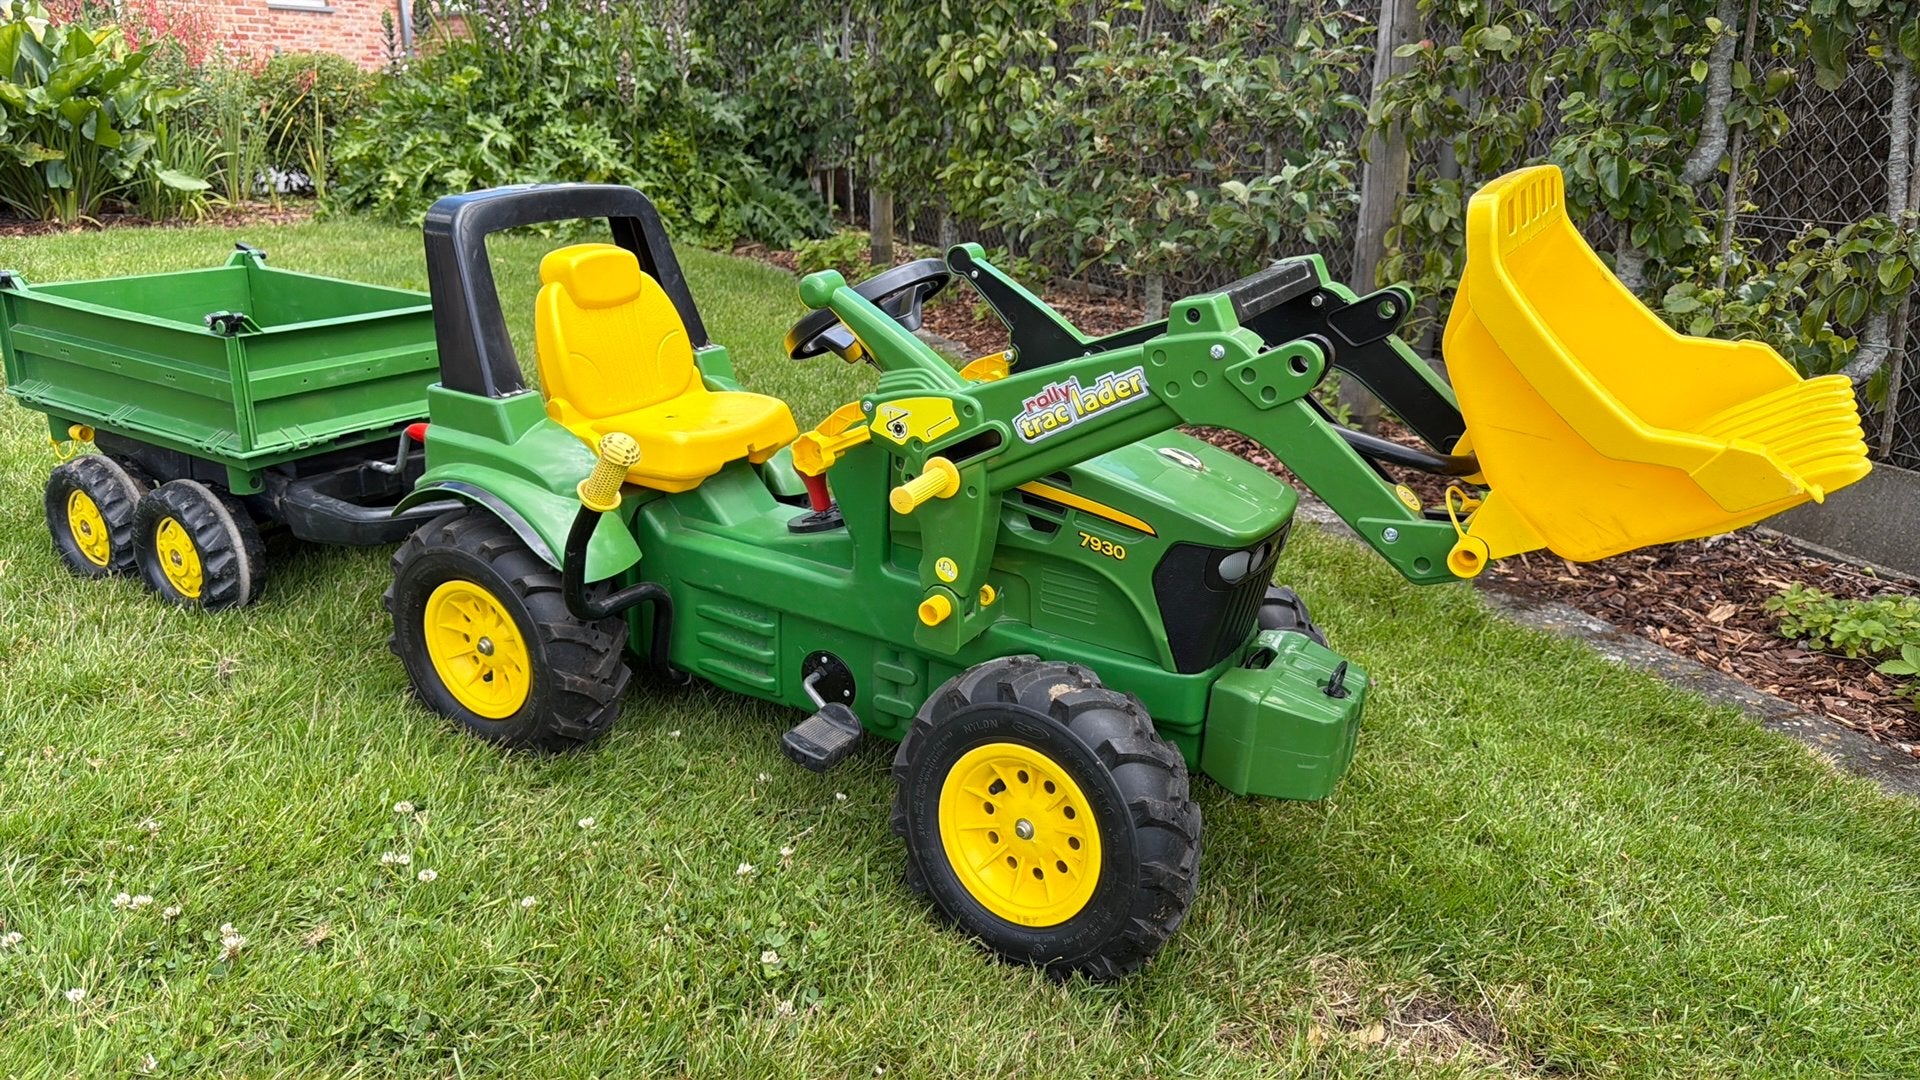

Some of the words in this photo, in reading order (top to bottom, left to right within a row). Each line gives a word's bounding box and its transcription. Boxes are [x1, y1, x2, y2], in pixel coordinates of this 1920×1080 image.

[1020, 404, 1070, 439] trac
[1070, 373, 1141, 417] lader
[1025, 384, 1071, 414] rolly
[1078, 531, 1126, 560] 7930
[963, 719, 999, 734] NYLON
